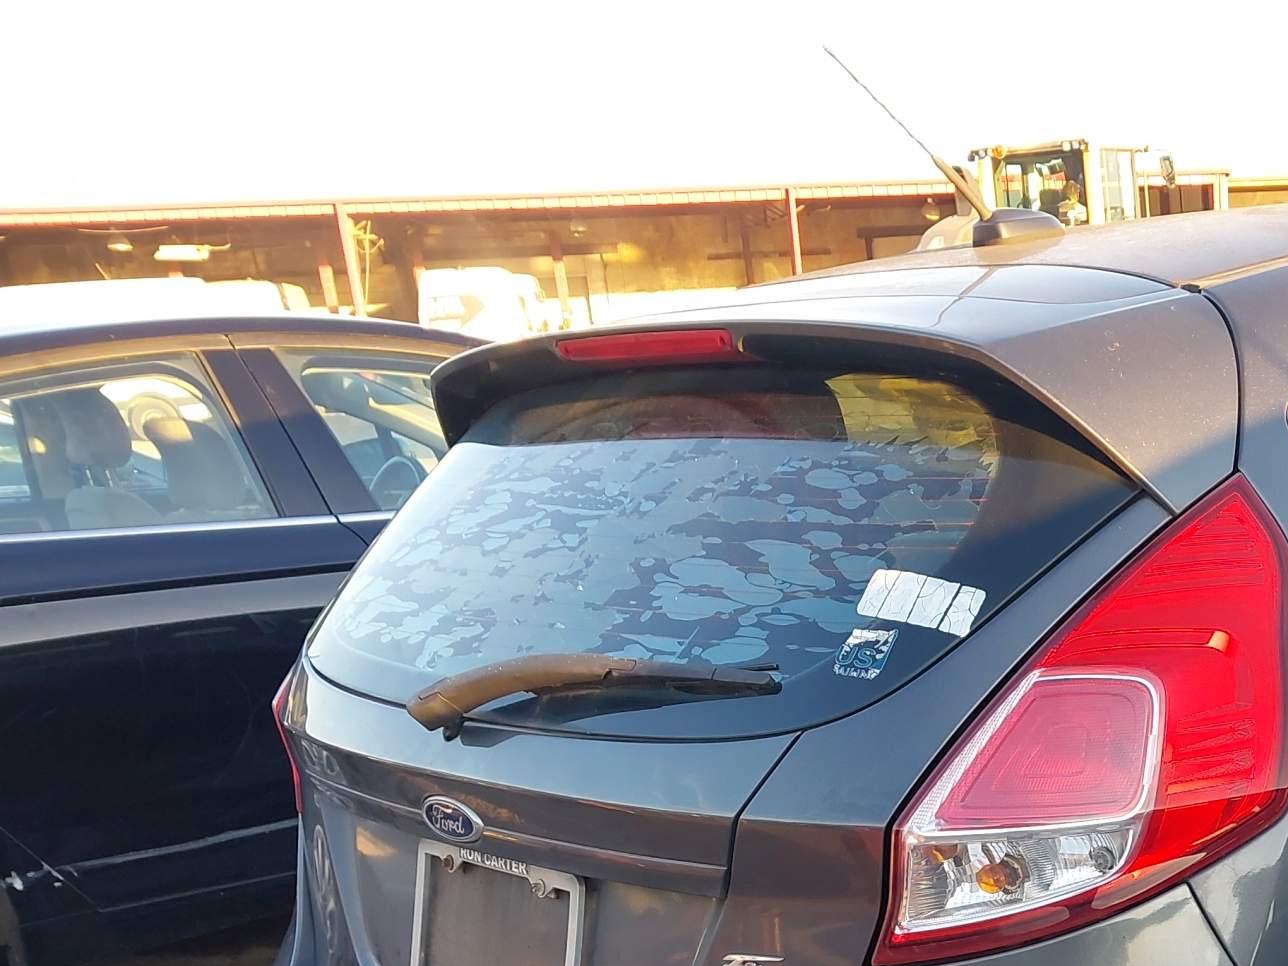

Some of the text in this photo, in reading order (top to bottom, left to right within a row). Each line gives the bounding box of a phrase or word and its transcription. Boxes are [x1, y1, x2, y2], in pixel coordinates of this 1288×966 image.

[432, 804, 465, 835] Ford
[460, 847, 528, 875] RON CARTER
